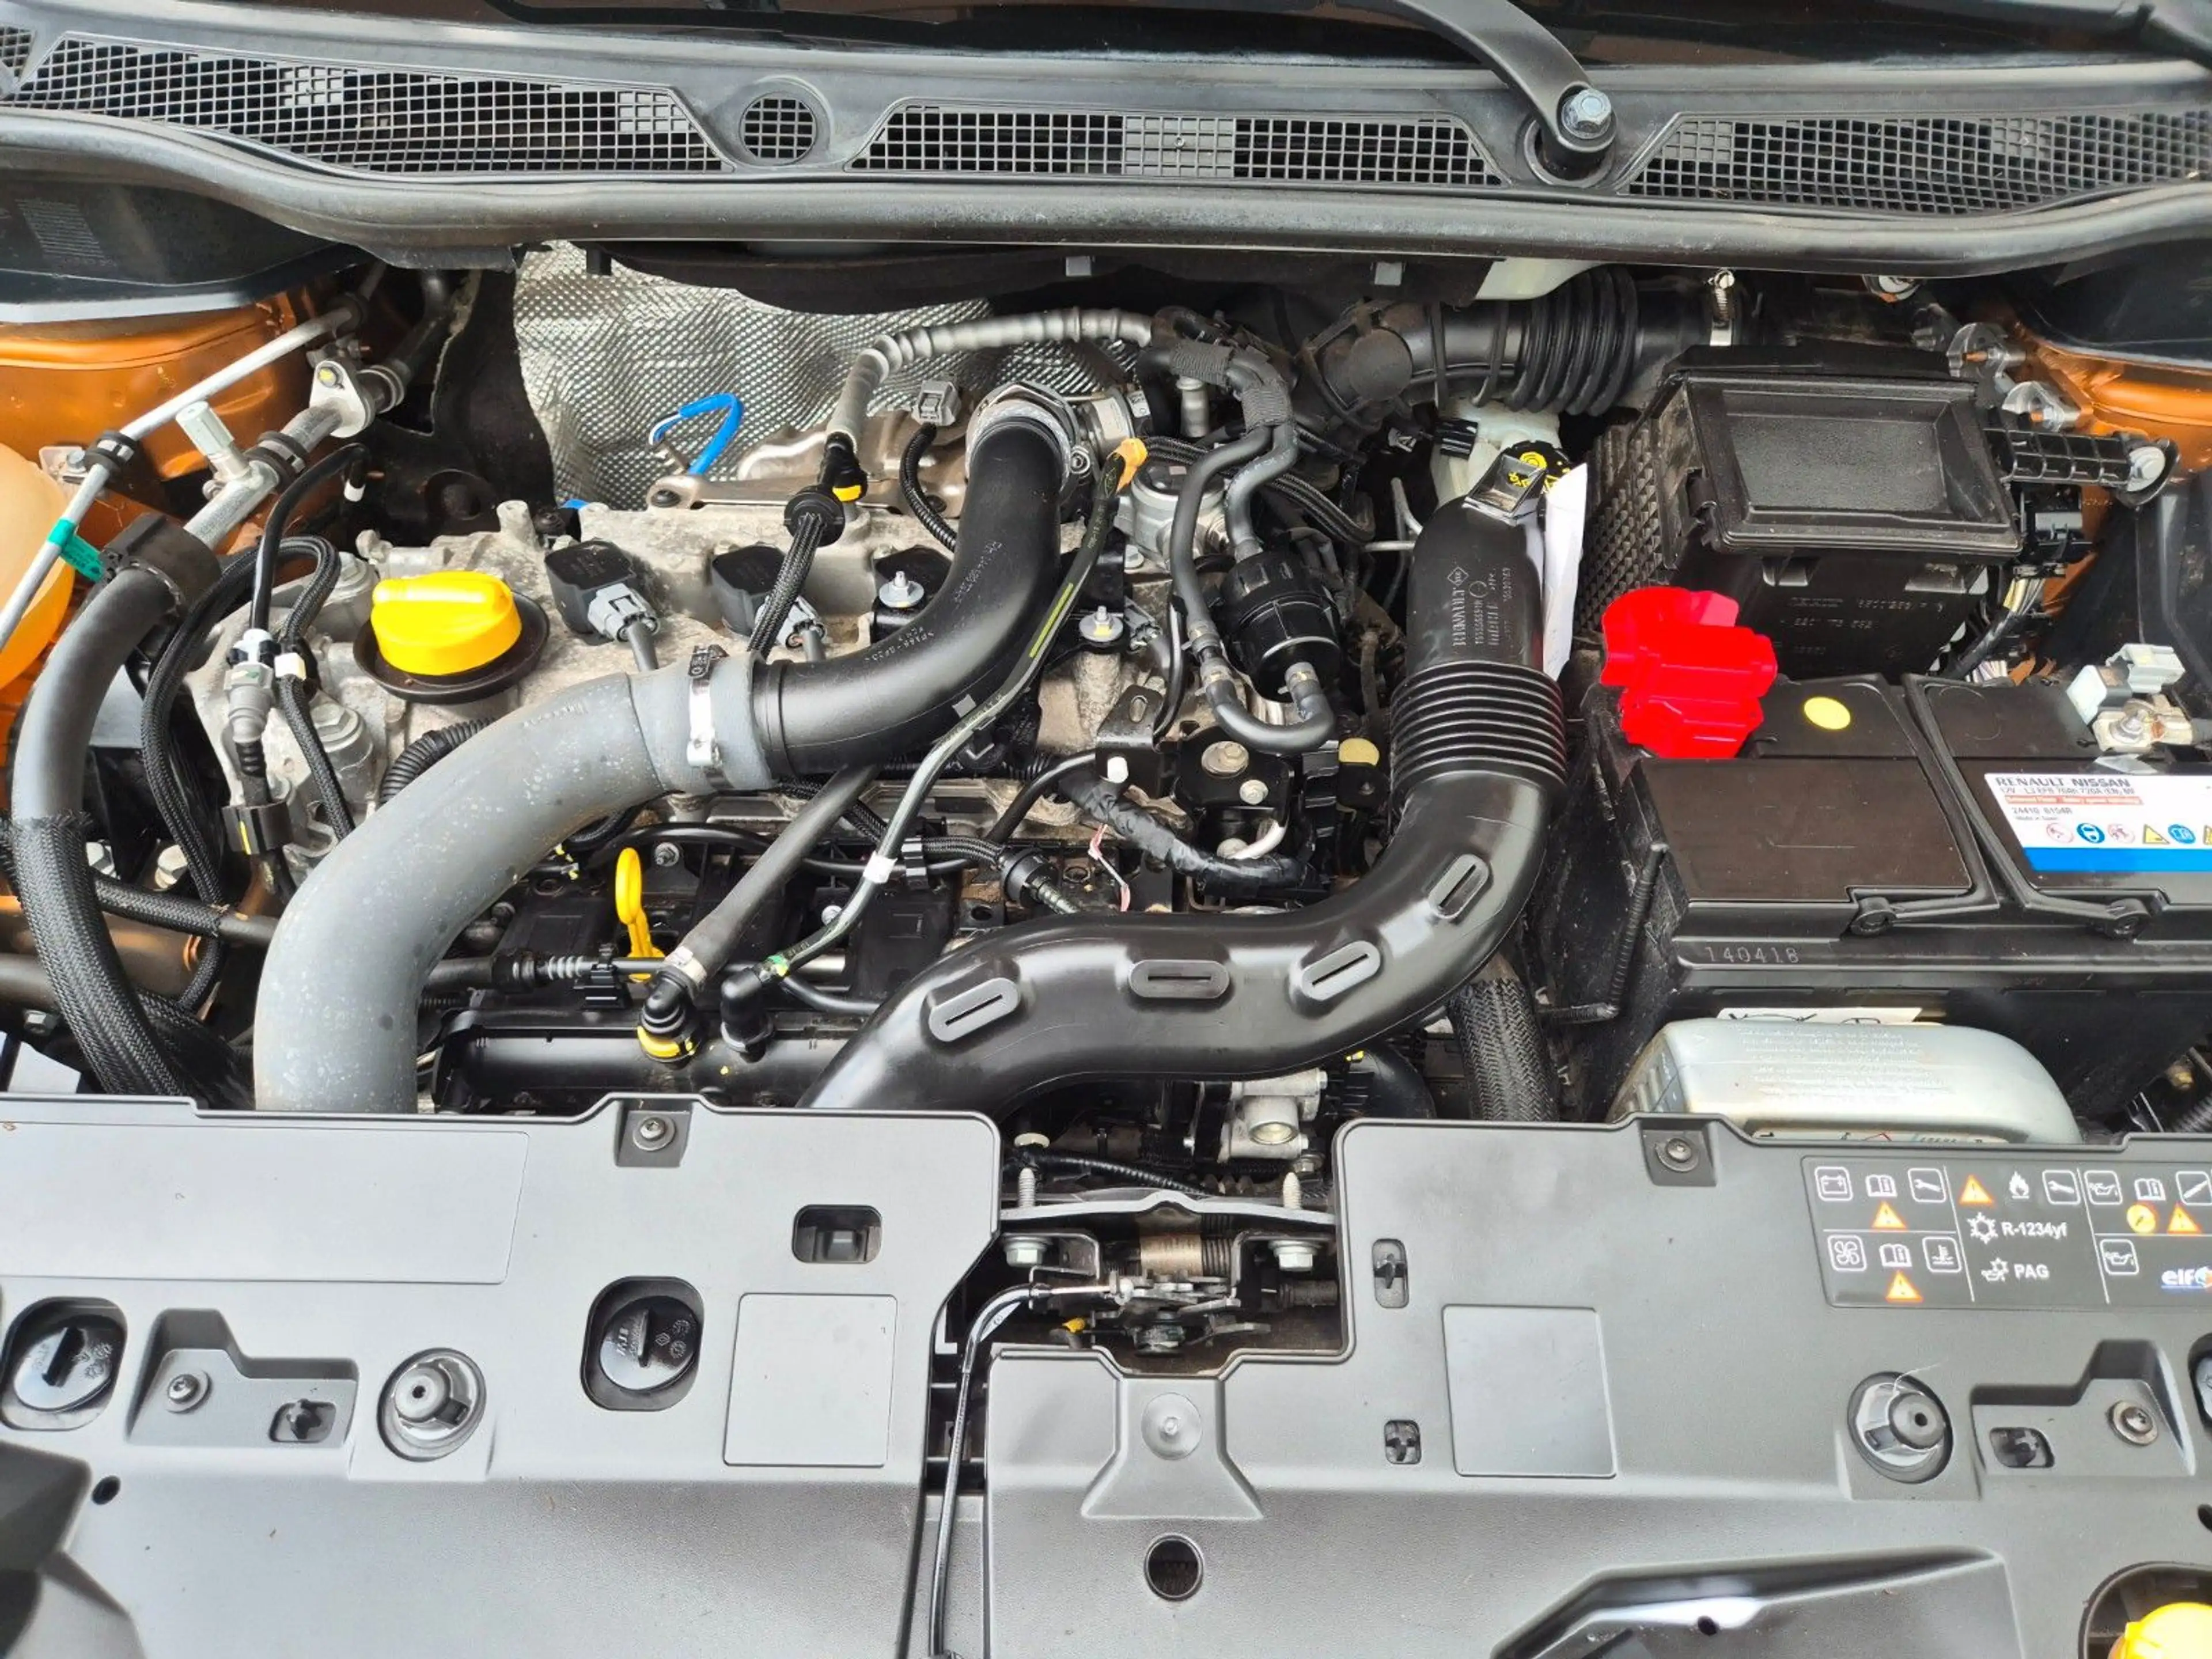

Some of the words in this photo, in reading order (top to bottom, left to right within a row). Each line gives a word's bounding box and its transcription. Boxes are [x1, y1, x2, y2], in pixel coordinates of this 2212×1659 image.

[1995, 777, 2064, 786] RENAULT
[2071, 778, 2131, 787] NISSAN
[2001, 1221, 2067, 1240] R-1234yf
[2014, 1263, 2050, 1280] PAG
